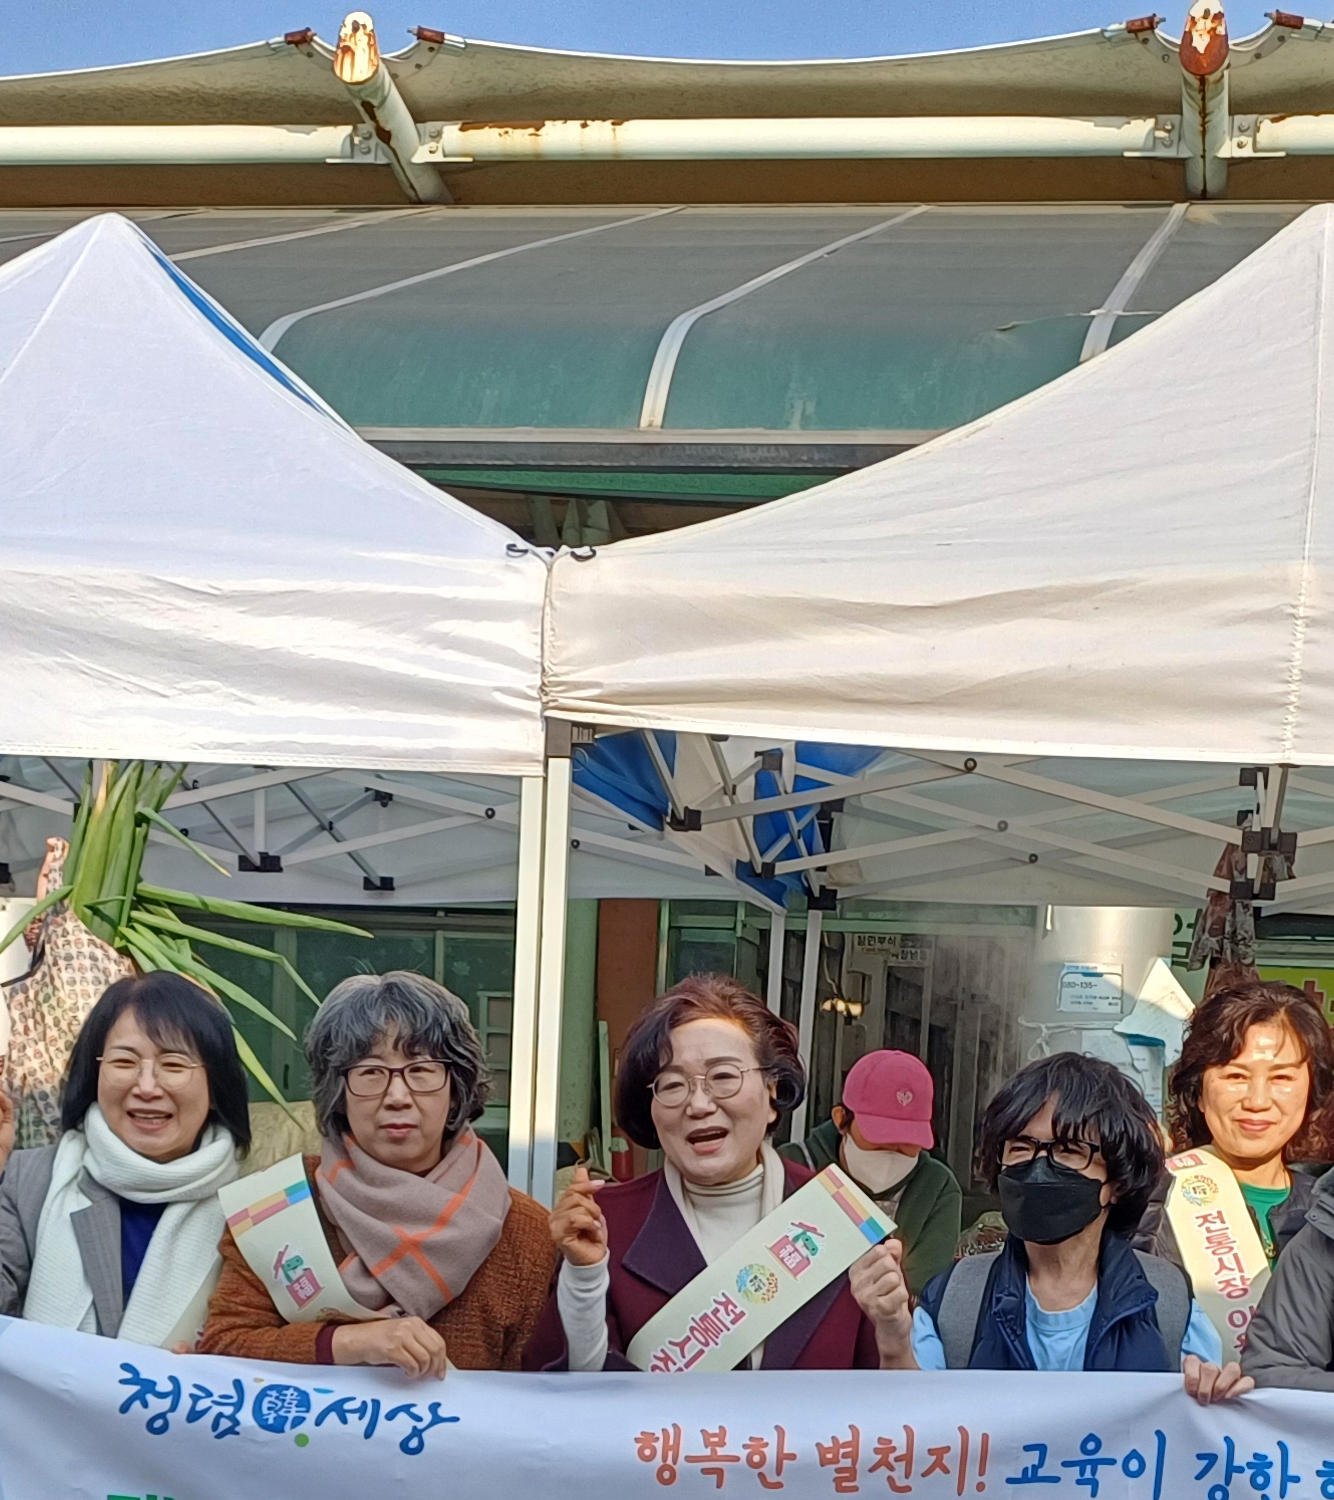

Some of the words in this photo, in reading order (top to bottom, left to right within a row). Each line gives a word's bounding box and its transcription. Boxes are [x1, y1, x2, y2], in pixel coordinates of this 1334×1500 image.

[1195, 1210, 1251, 1300] 전통시장
[636, 1426, 798, 1491] 행복한
[816, 1424, 990, 1497] 별천지!
